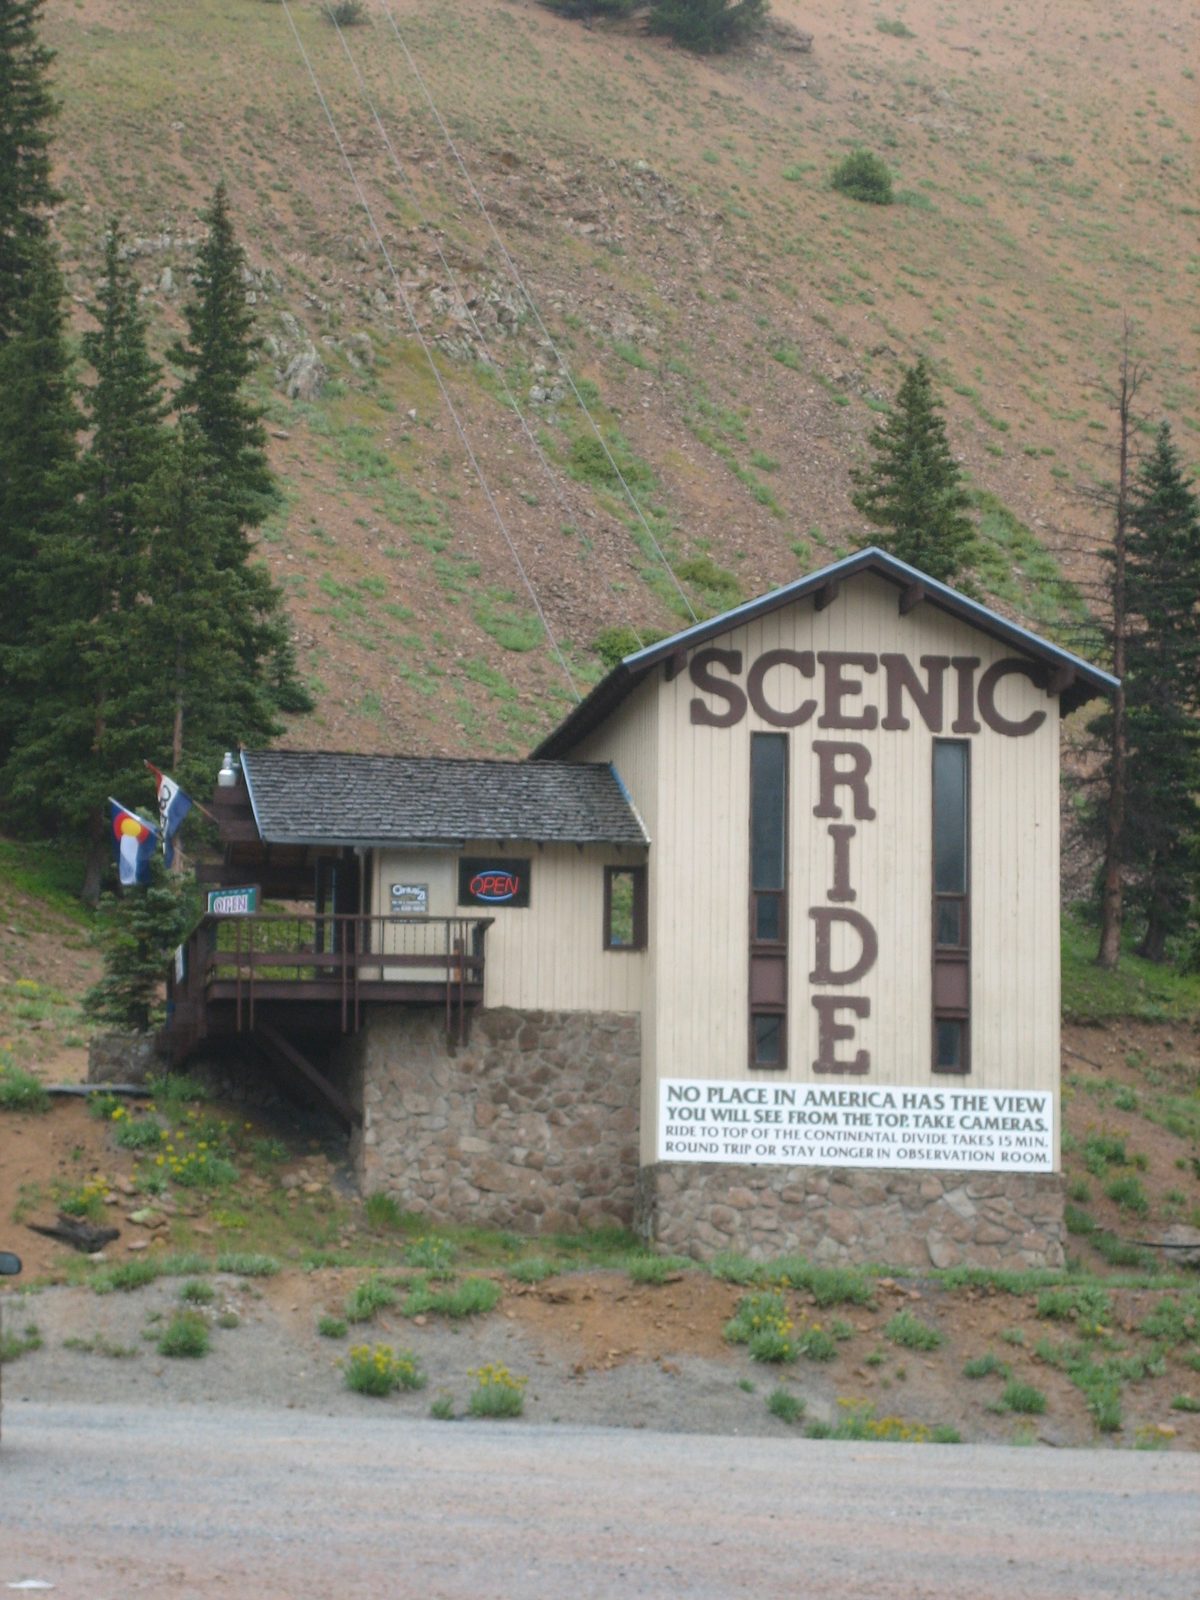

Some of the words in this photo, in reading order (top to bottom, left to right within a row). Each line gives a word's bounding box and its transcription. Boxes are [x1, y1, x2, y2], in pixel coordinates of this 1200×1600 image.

[689, 647, 1047, 737] SCENIC
[470, 876, 520, 896] OPEN
[213, 894, 249, 914] OPEN
[808, 740, 878, 1075] RIDE
[667, 1085, 701, 1103] NO
[706, 1087, 768, 1105] PLACE
[774, 1089, 796, 1106] IN
[803, 1090, 897, 1110] AMERICA
[902, 1093, 946, 1110] HAS
[950, 1094, 989, 1112] THE
[993, 1096, 1047, 1113] VIEW
[666, 1106, 706, 1121] YOU
[711, 1108, 750, 1122] WILL
[753, 1109, 783, 1124] SEE
[788, 1110, 838, 1126] FROM
[843, 1112, 873, 1127] THE
[875, 1113, 910, 1128] TOP.
[912, 1114, 956, 1129] TAKE
[959, 1115, 1049, 1132] CAMERAS.
[665, 1125, 696, 1137] RIDE
[699, 1126, 719, 1138] TO
[722, 1126, 749, 1139] TOP
[751, 1127, 769, 1139] OF
[774, 1128, 801, 1140] THE
[803, 1129, 898, 1144] CONTINENTAL
[902, 1132, 949, 1145] DIVIDE
[951, 1133, 994, 1147] TAKES
[998, 1135, 1013, 1147] 15
[1015, 1135, 1049, 1148] MIN.
[665, 1141, 719, 1154] ROUND
[722, 1142, 752, 1155] TRIP
[755, 1144, 777, 1156] OR
[781, 1145, 816, 1157] STAY
[819, 1146, 874, 1159] LONGER
[877, 1148, 891, 1159] IN
[896, 1148, 995, 1162] OBSERVATION
[1000, 1151, 1051, 1164] ROOM.
